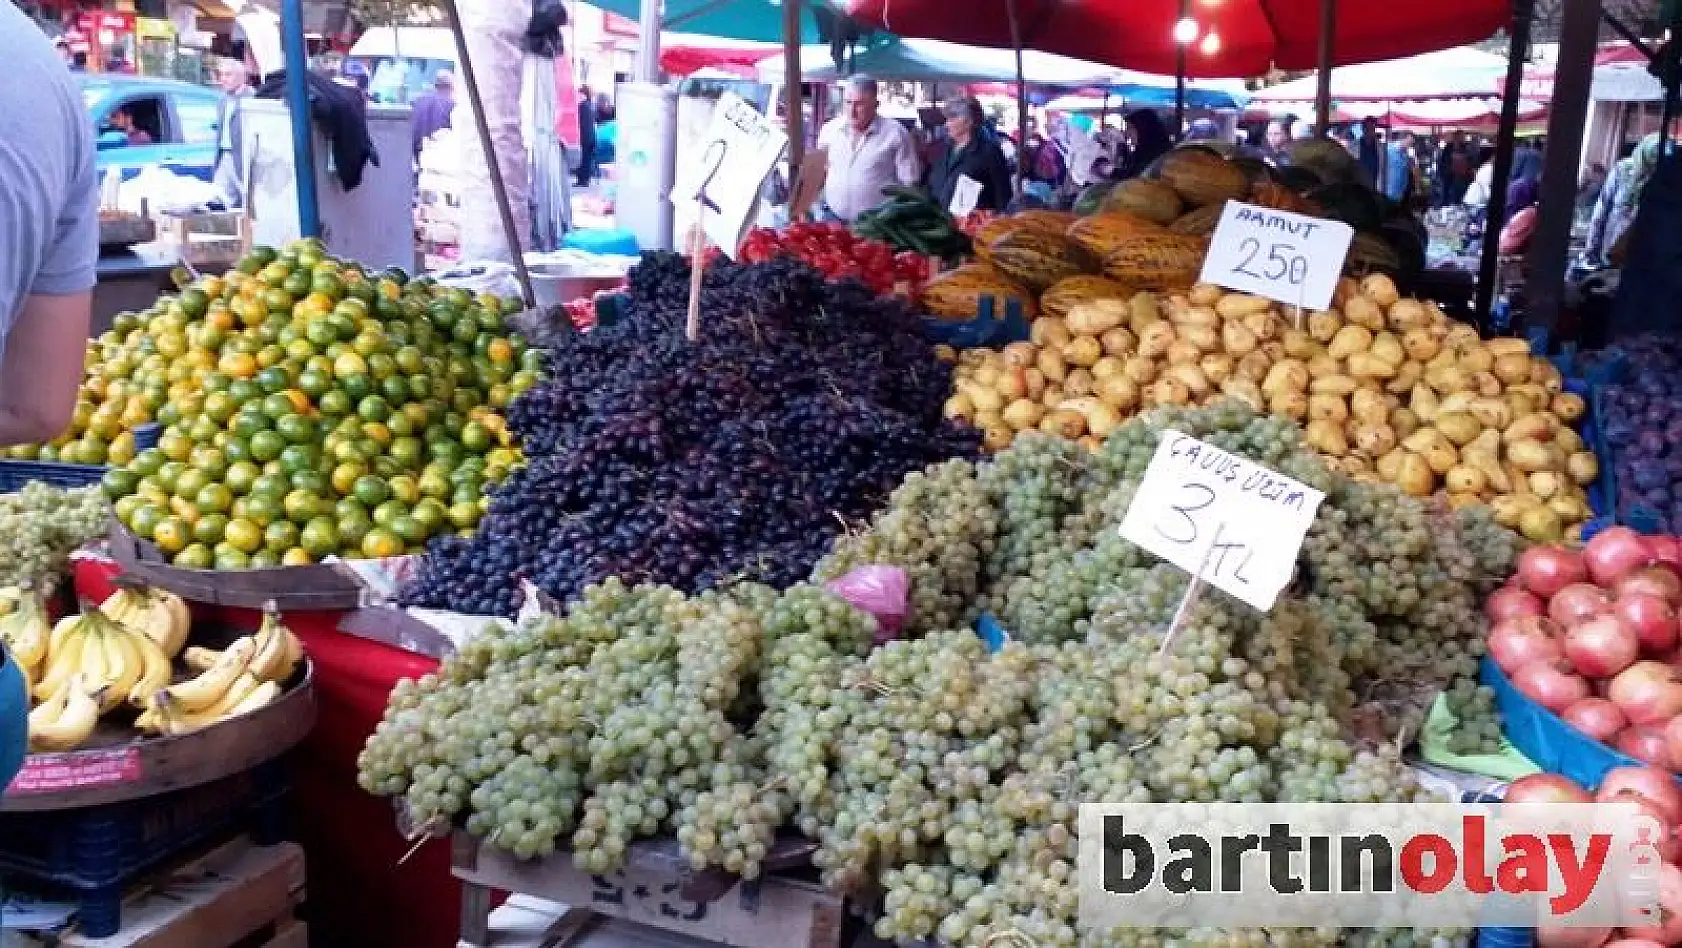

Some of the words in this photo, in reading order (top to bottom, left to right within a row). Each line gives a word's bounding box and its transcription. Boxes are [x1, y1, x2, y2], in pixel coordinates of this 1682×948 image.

[693, 138, 726, 215] 2
[1231, 236, 1308, 285] 250
[1154, 482, 1216, 544] 3
